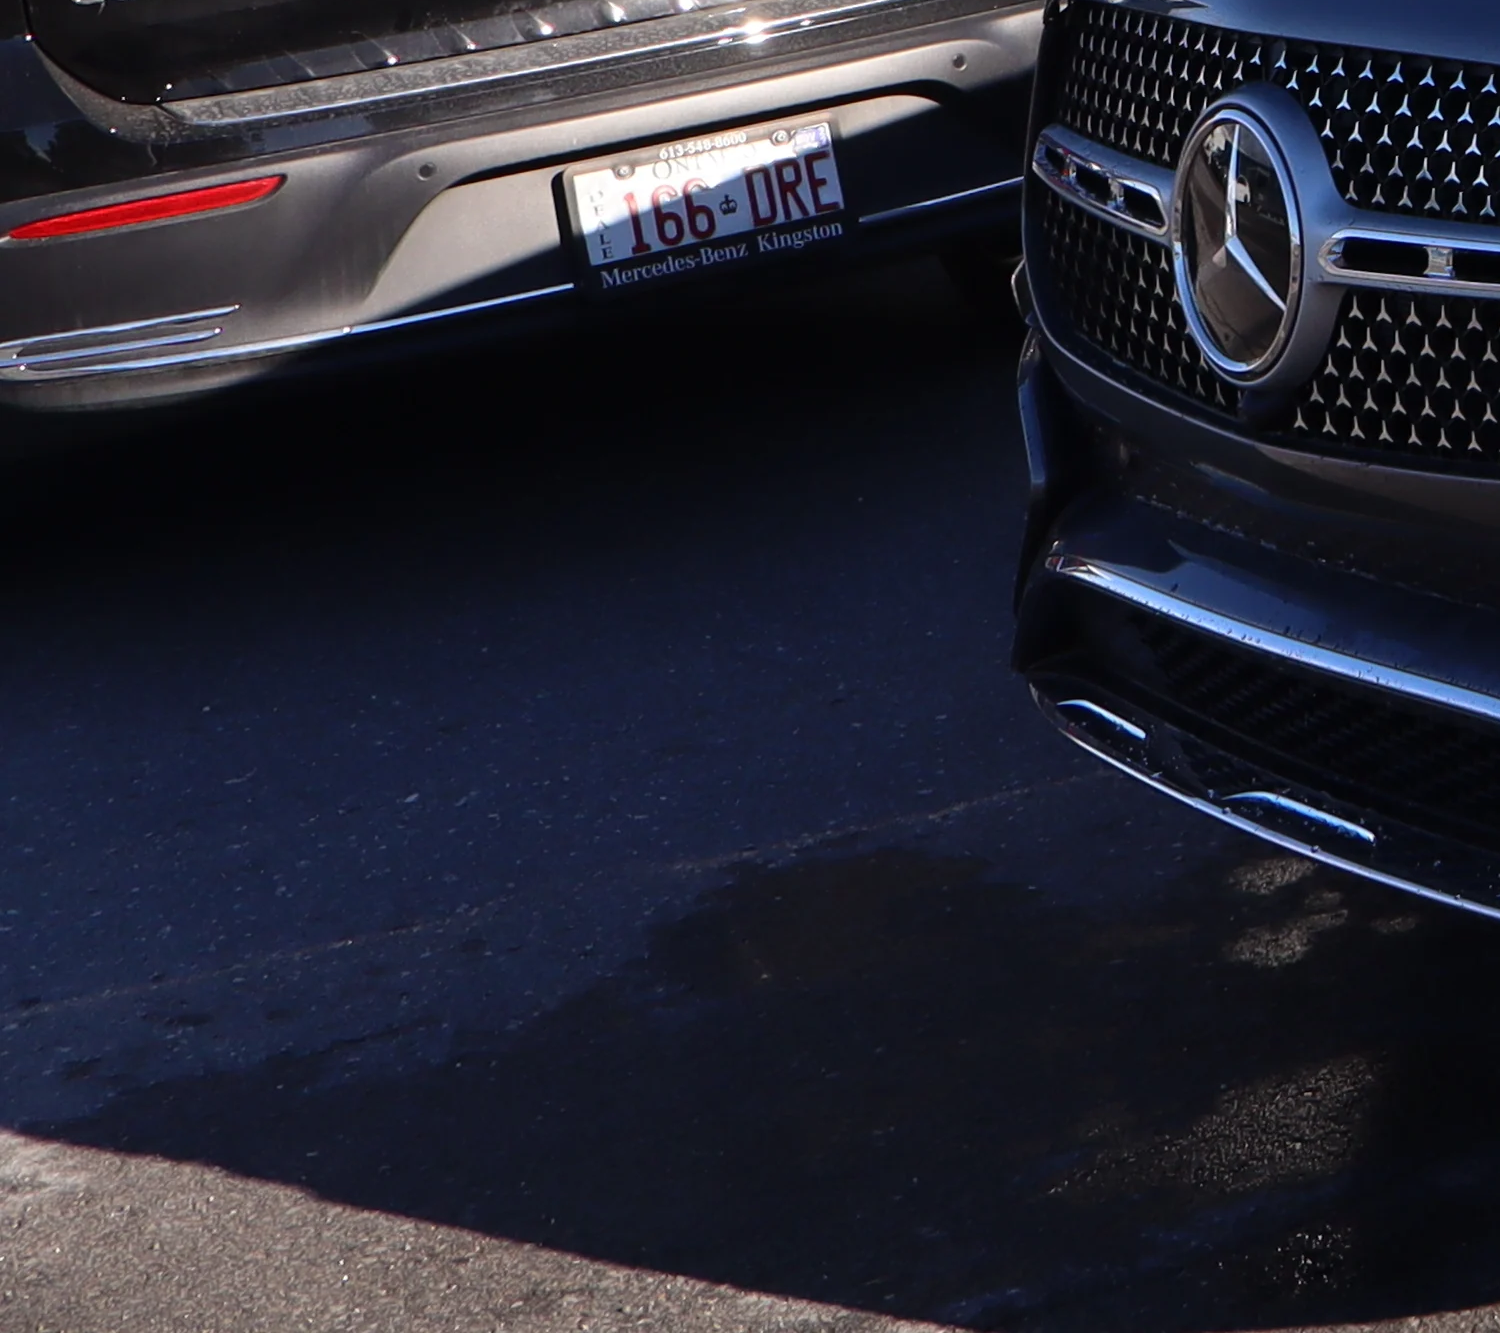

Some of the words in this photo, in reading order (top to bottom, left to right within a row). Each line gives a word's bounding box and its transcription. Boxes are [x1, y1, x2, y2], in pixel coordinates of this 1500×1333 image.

[622, 178, 717, 256] 166
[742, 150, 841, 228] DRE
[599, 242, 750, 289] Mercedes-Benz
[756, 221, 844, 254] Kingston
